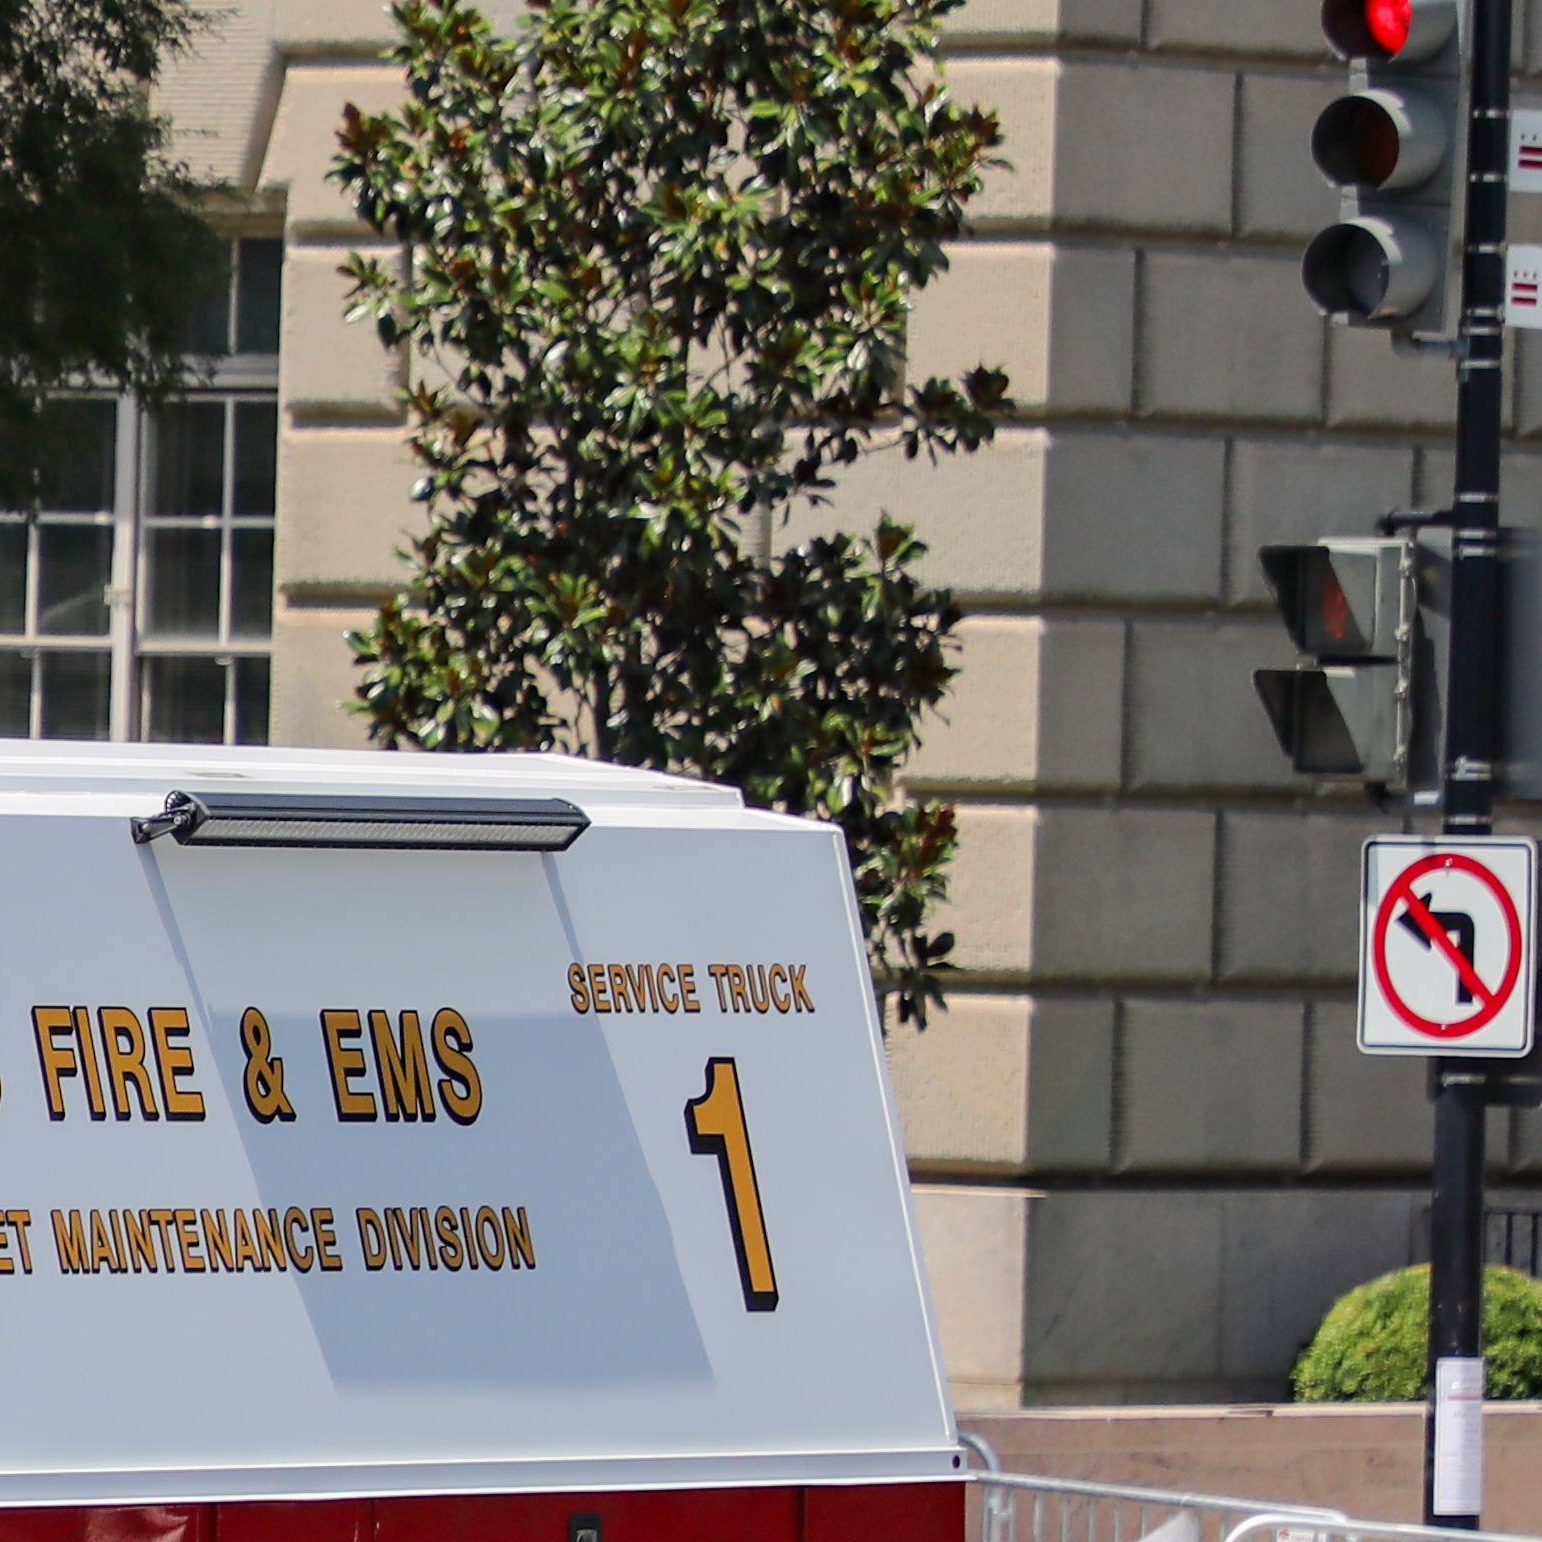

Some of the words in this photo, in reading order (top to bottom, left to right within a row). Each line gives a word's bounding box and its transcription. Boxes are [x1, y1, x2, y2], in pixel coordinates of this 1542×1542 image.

[567, 962, 701, 1015] SERVICE
[708, 963, 815, 1015] TRUCK
[31, 1005, 206, 1122] FIRE
[240, 1007, 296, 1124] &
[320, 1008, 483, 1125] EMS
[684, 1056, 779, 1312] 1
[51, 1207, 343, 1274] MAINTENANCE
[357, 1206, 536, 1272] DIVISION
